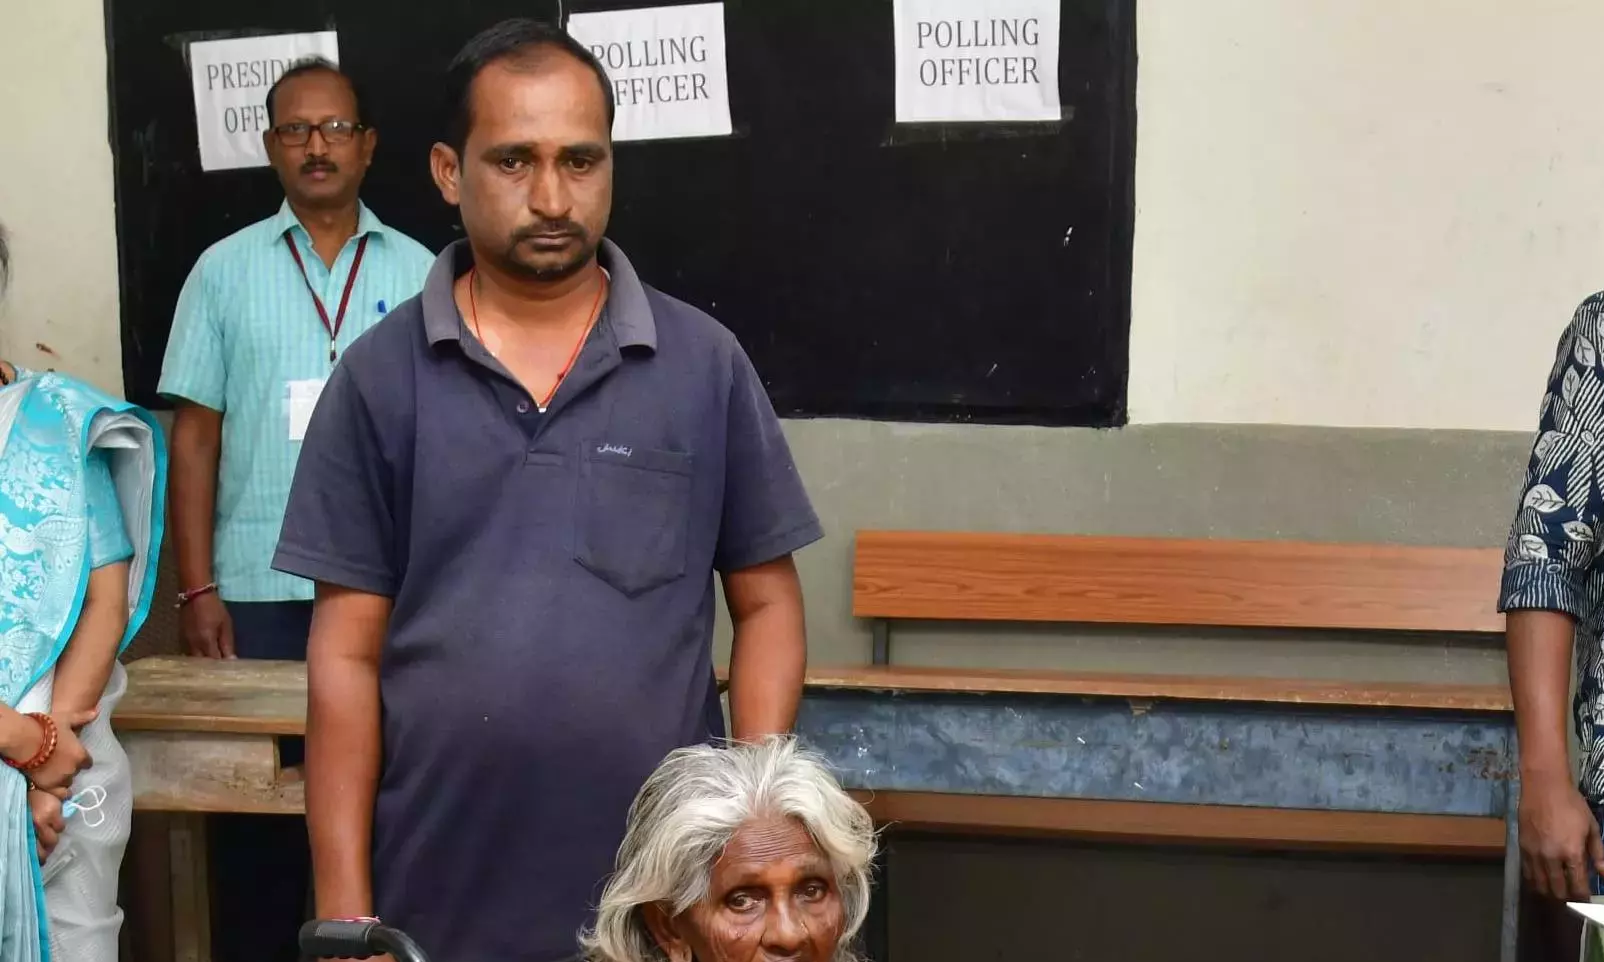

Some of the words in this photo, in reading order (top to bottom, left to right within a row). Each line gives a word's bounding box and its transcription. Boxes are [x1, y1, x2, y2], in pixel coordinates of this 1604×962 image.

[916, 17, 1040, 49] POLLING
[590, 35, 707, 70] POLLING
[206, 58, 293, 91] PRESID
[919, 56, 1041, 87] OFFICER
[613, 73, 710, 107] FFICER
